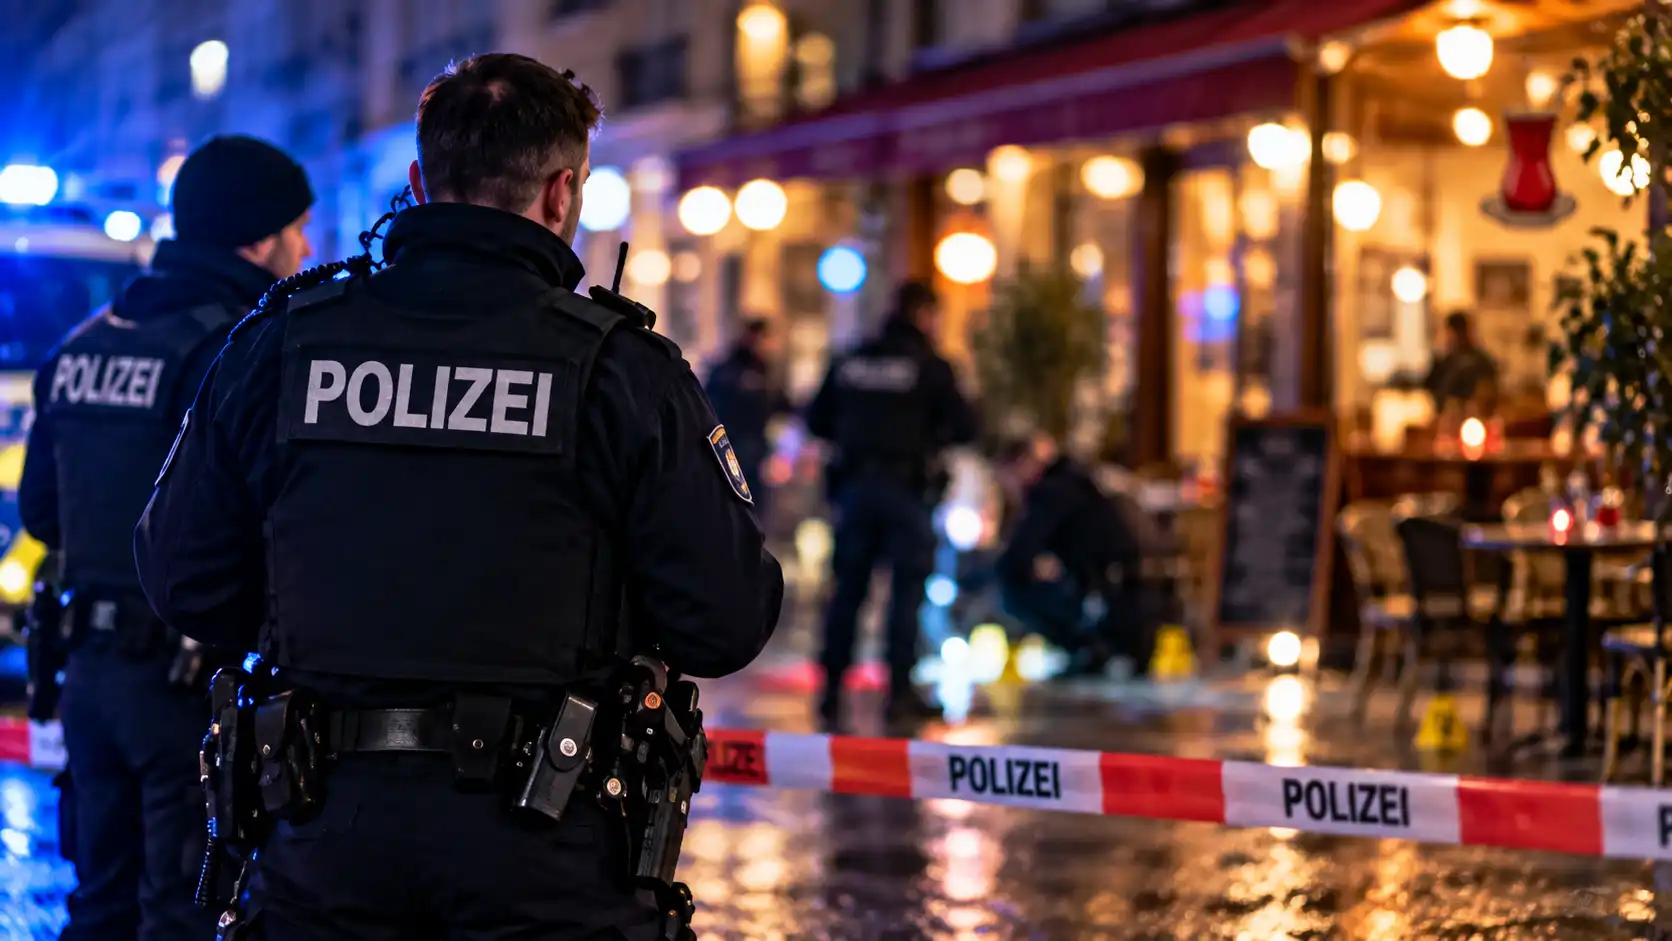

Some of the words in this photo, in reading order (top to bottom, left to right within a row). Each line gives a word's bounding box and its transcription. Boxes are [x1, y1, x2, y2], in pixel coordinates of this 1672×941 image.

[51, 353, 164, 408] POLIZEI
[304, 359, 553, 437] POLIZEI
[948, 754, 1061, 800] POLIZEI
[1282, 778, 1410, 828] POLIZEI
